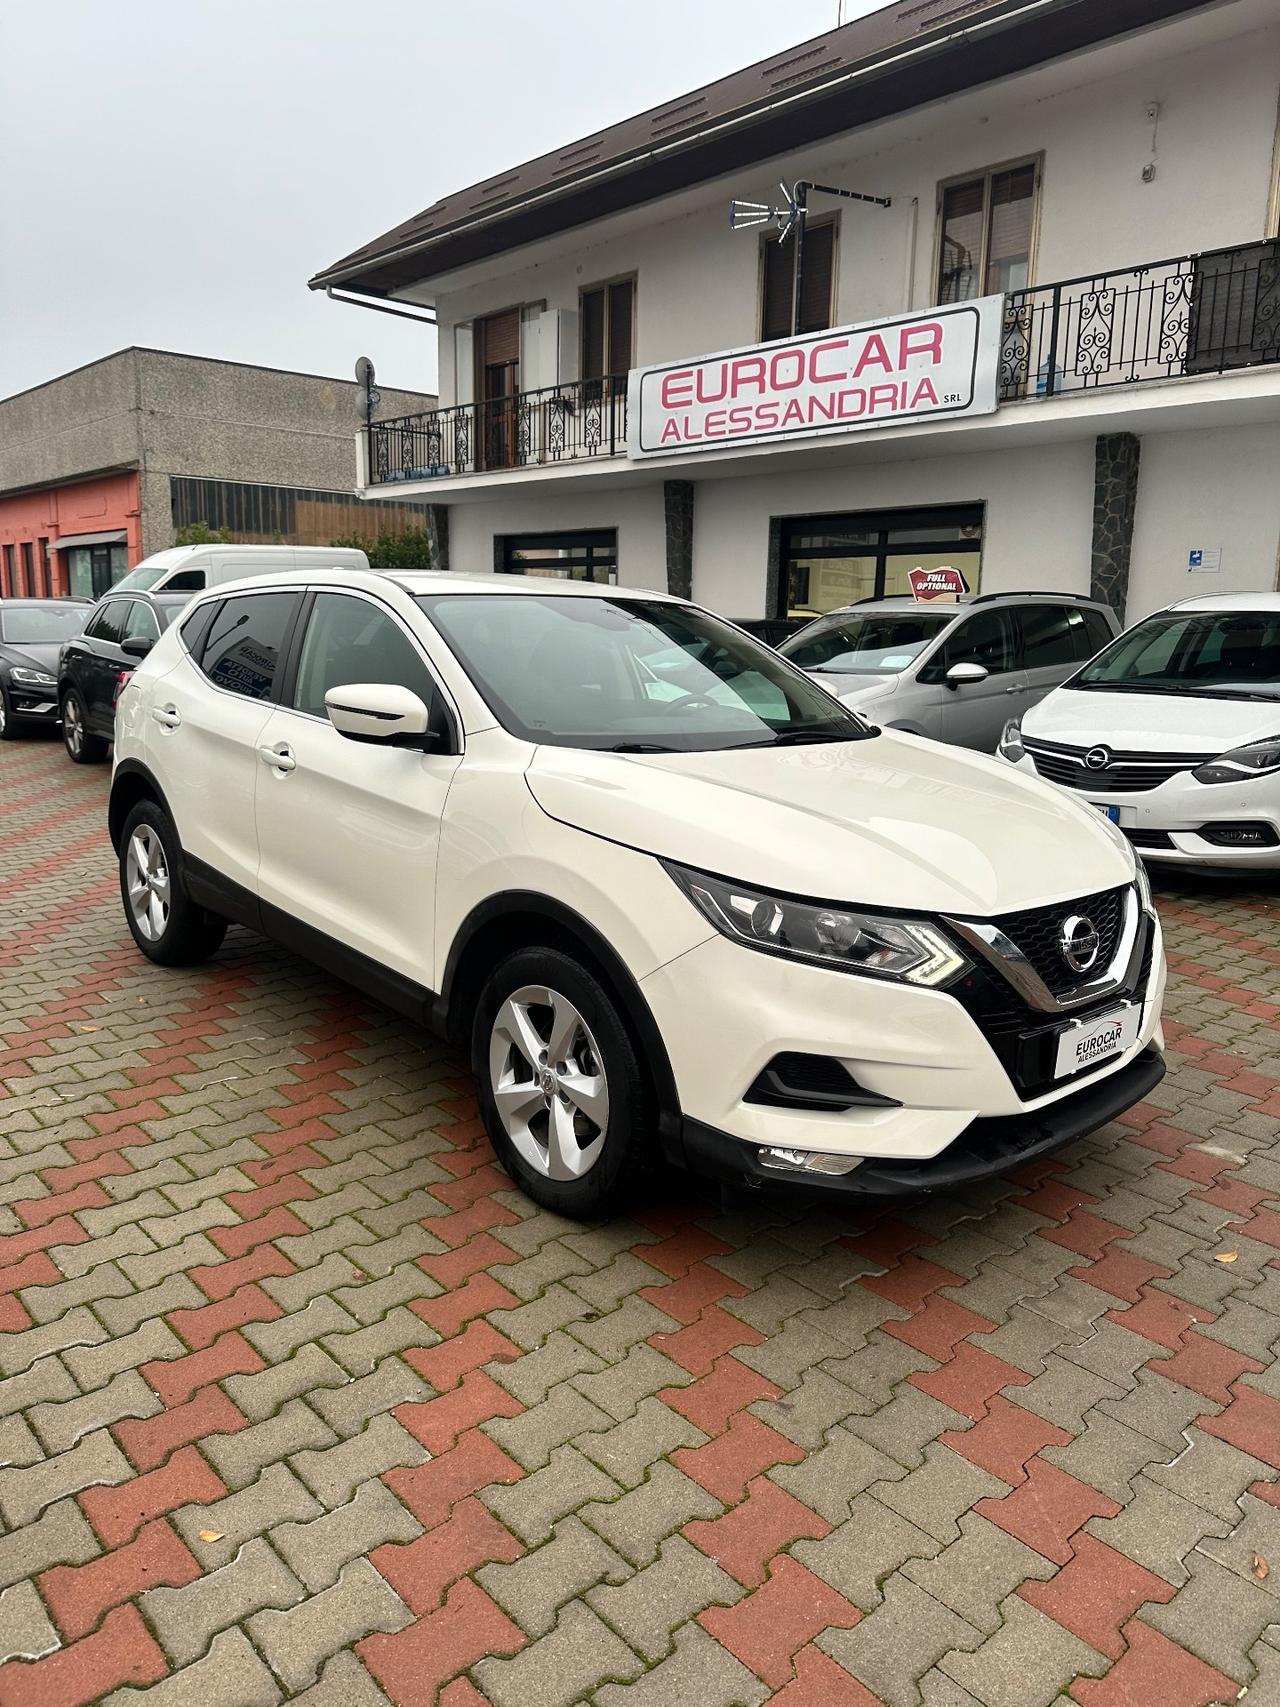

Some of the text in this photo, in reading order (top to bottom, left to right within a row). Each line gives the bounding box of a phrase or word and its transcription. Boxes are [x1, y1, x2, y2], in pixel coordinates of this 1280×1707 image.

[661, 322, 944, 410] EUROCAR
[660, 377, 939, 444] ALESSANDRIA
[943, 394, 962, 405] SRL
[916, 582, 957, 591] OPTIONAL
[926, 574, 946, 582] FULL
[1075, 1027, 1123, 1057] EUROCAR
[1077, 1041, 1117, 1064] ALESSANDRIA
